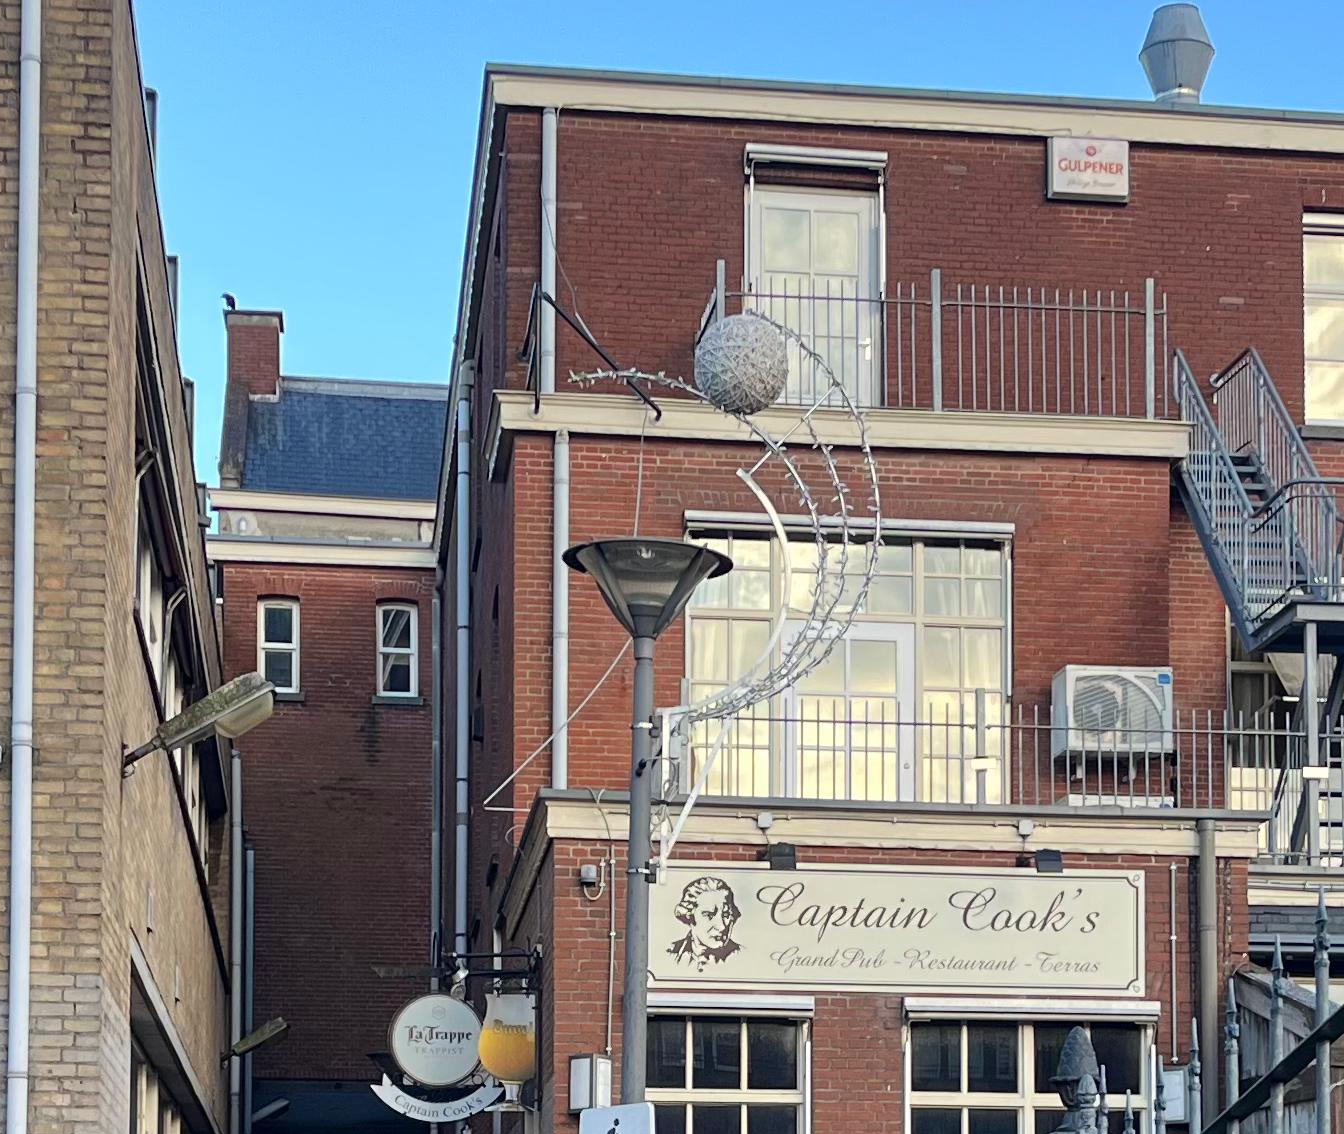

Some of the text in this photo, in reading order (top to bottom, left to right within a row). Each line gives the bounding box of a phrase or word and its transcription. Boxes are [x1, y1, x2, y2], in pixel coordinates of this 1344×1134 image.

[1058, 157, 1123, 176] GULPENER
[756, 882, 1100, 943] Captain Cook's
[769, 946, 841, 974] Grand
[841, 947, 888, 969] Pub
[903, 948, 1017, 971] Restaurant
[1036, 951, 1101, 973] Terras
[423, 1025, 472, 1044] Trappe
[395, 1095, 482, 1117] Captain Cook's
